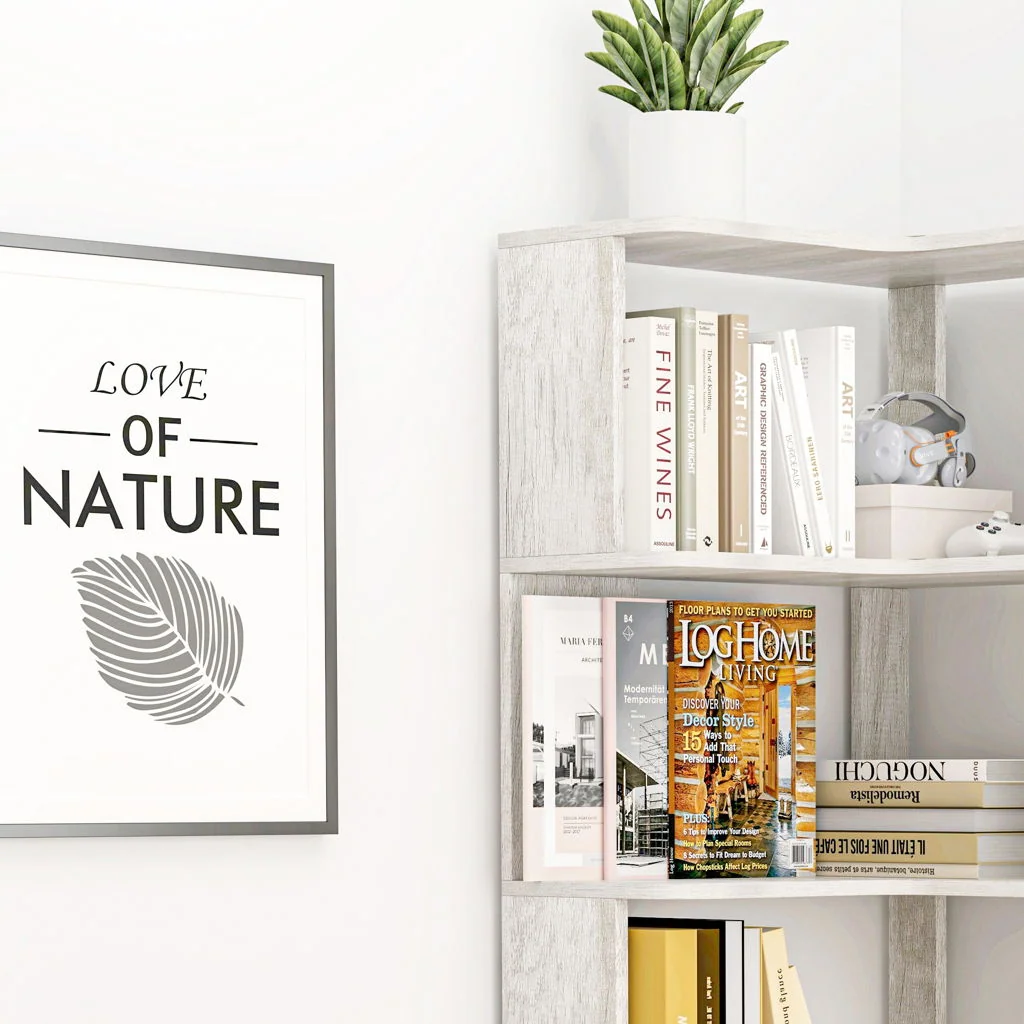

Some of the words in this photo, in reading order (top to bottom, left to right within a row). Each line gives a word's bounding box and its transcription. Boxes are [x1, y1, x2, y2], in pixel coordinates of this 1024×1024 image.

[90, 360, 207, 400] LOVE
[656, 350, 671, 412] FINE
[759, 362, 767, 407] GRAPHIC
[735, 371, 747, 409] ART
[842, 381, 853, 418] ART
[122, 413, 181, 457] OF
[759, 410, 767, 446] DESIGN
[656, 427, 672, 519] WINES
[759, 450, 767, 515] REFERENCED
[23, 465, 279, 536] NATURE
[679, 605, 704, 615] FLOOR
[706, 605, 731, 616] PLANS
[733, 606, 743, 616] TO
[745, 607, 760, 617] GET
[763, 608, 778, 617] YOU
[780, 608, 813, 618] STARTED
[560, 636, 586, 646] MARIA
[720, 664, 777, 681] LIVING
[623, 684, 665, 694] Modernität
[683, 698, 718, 709] DISCOVER
[720, 698, 740, 709] YOUR
[683, 713, 719, 727] Decor
[722, 713, 754, 731] Style
[683, 730, 702, 751] 15
[703, 730, 722, 741] Ways
[724, 731, 732, 739] to
[703, 742, 718, 751] Add
[720, 742, 737, 751] That
[683, 754, 715, 763] Personal
[717, 754, 738, 764] Touch
[836, 761, 946, 782] NOGUCHI
[851, 790, 920, 803] Remodelista
[838, 838, 849, 854] LE
[851, 838, 869, 855] FOIS
[872, 839, 888, 855] UNE
[891, 839, 915, 858] ÉTAIT
[918, 839, 926, 855] IL
